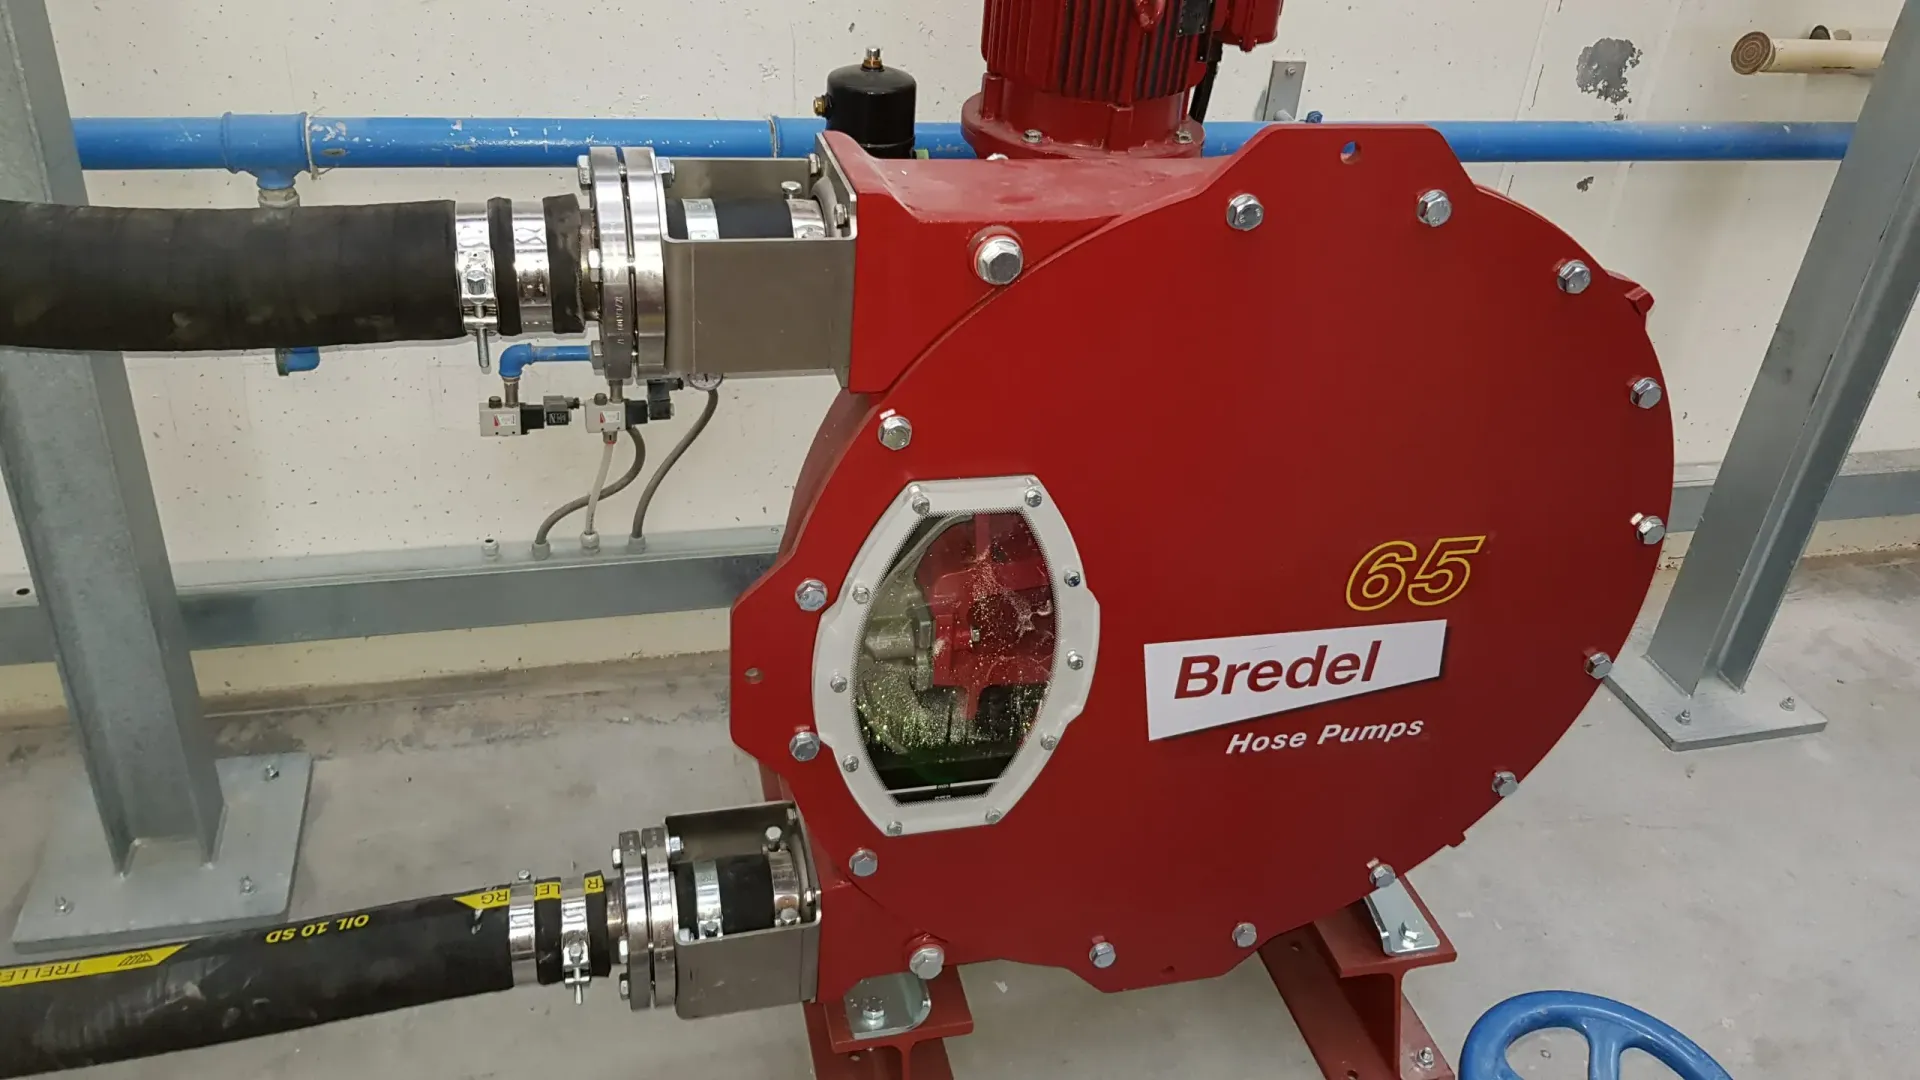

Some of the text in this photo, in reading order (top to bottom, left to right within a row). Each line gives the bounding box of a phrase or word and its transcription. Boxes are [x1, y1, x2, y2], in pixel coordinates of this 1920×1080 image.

[1345, 536, 1487, 611] 65
[1174, 640, 1382, 699] Bredel
[1225, 718, 1425, 755] Hose Pumps
[265, 914, 370, 943] OIL 10 SD
[0, 961, 82, 983] TRELLE
